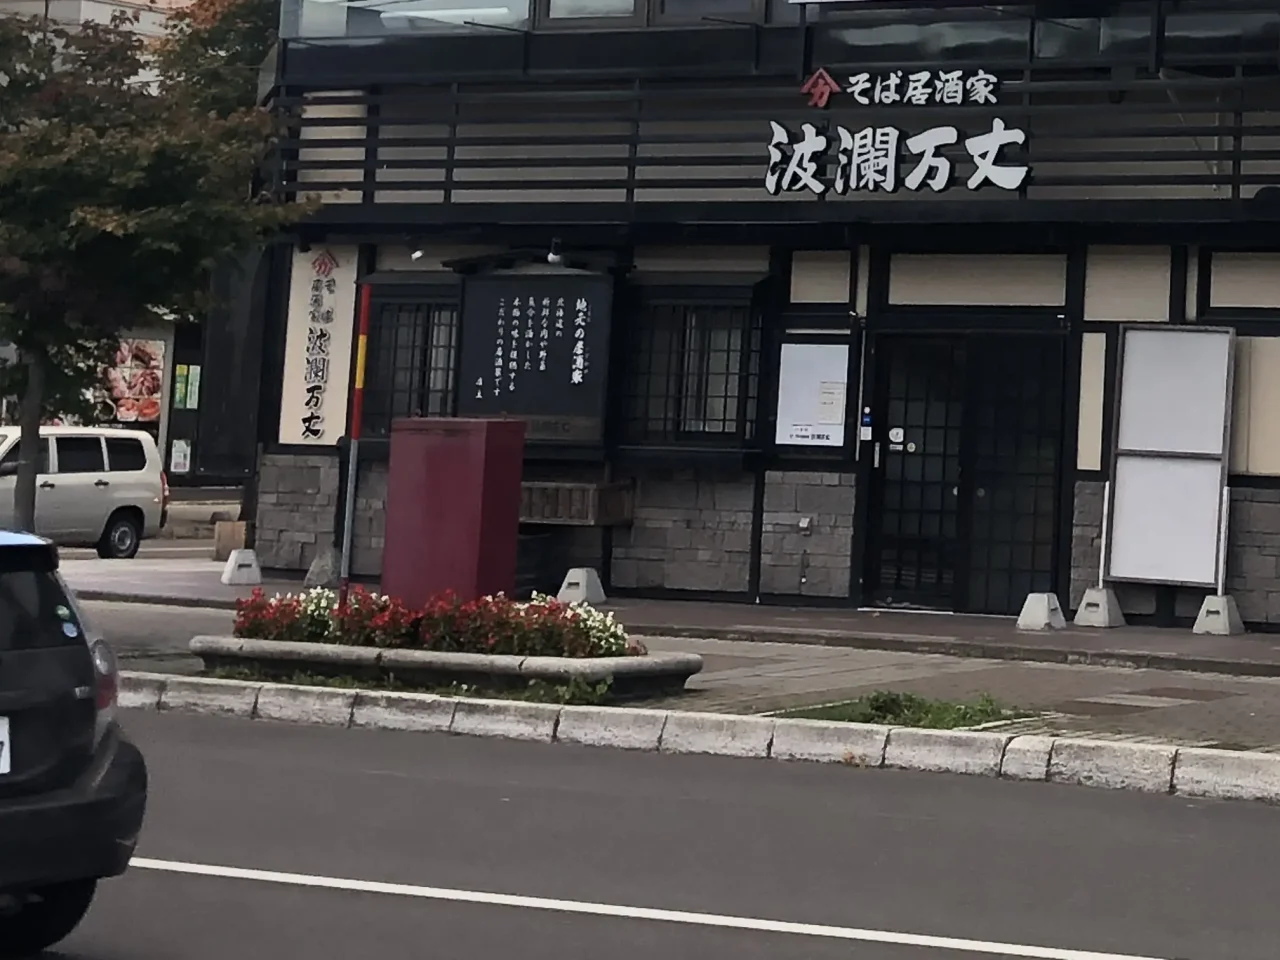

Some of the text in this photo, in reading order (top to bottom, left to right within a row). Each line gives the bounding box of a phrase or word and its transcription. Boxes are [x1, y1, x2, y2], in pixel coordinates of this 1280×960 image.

[846, 69, 998, 106] そば居酒家
[765, 117, 1029, 194] 波瀾万丈
